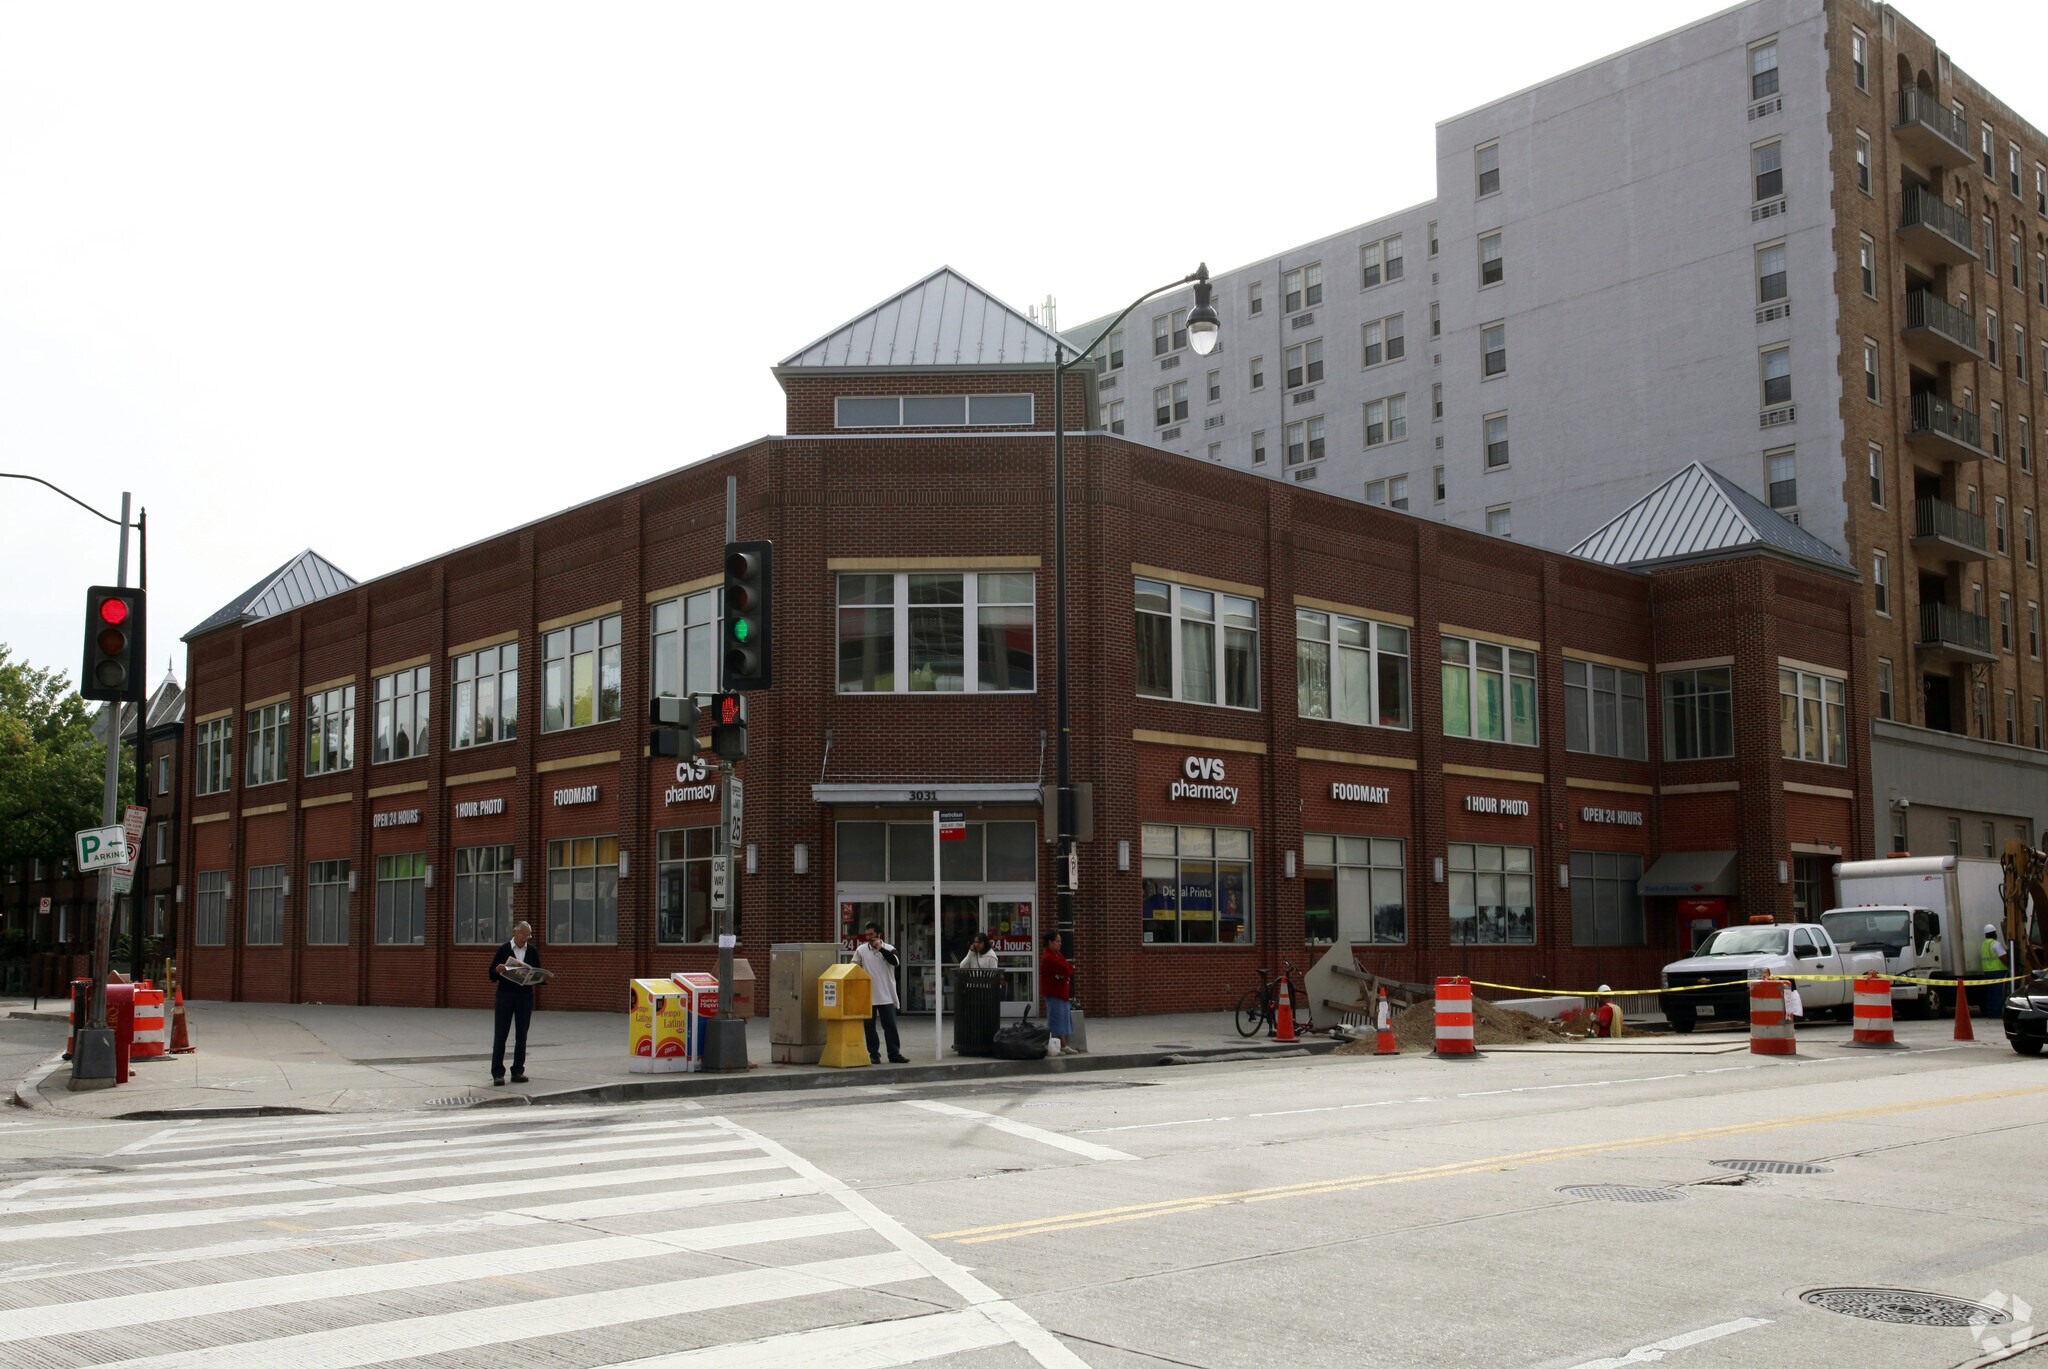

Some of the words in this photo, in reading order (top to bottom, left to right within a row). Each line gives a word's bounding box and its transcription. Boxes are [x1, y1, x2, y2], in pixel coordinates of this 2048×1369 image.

[676, 755, 706, 783] CVS
[1185, 756, 1225, 781] CVS
[553, 785, 598, 807] FOODMART
[665, 784, 716, 807] pharmacy
[909, 791, 938, 801] 3031
[1171, 779, 1239, 804] pharmacy
[1332, 783, 1389, 804] FOODMART
[480, 798, 502, 815] PHOTO
[1500, 799, 1529, 816] PHOTO
[373, 813, 388, 827] OPEN
[389, 812, 397, 826] 24
[398, 809, 418, 824] HOURS
[1583, 807, 1603, 822] OPEN
[1606, 809, 1616, 824] 24
[1617, 809, 1643, 826] HOURS
[732, 816, 741, 841] 25
[714, 861, 725, 872] ONE
[714, 876, 724, 886] WAY
[1163, 885, 1188, 899] Digal
[1190, 886, 1212, 898] Prints
[843, 904, 853, 912] 24
[1020, 904, 1029, 913] 24
[842, 939, 854, 951] 24
[1004, 939, 1031, 951] hours
[664, 1018, 685, 1029] Latino
